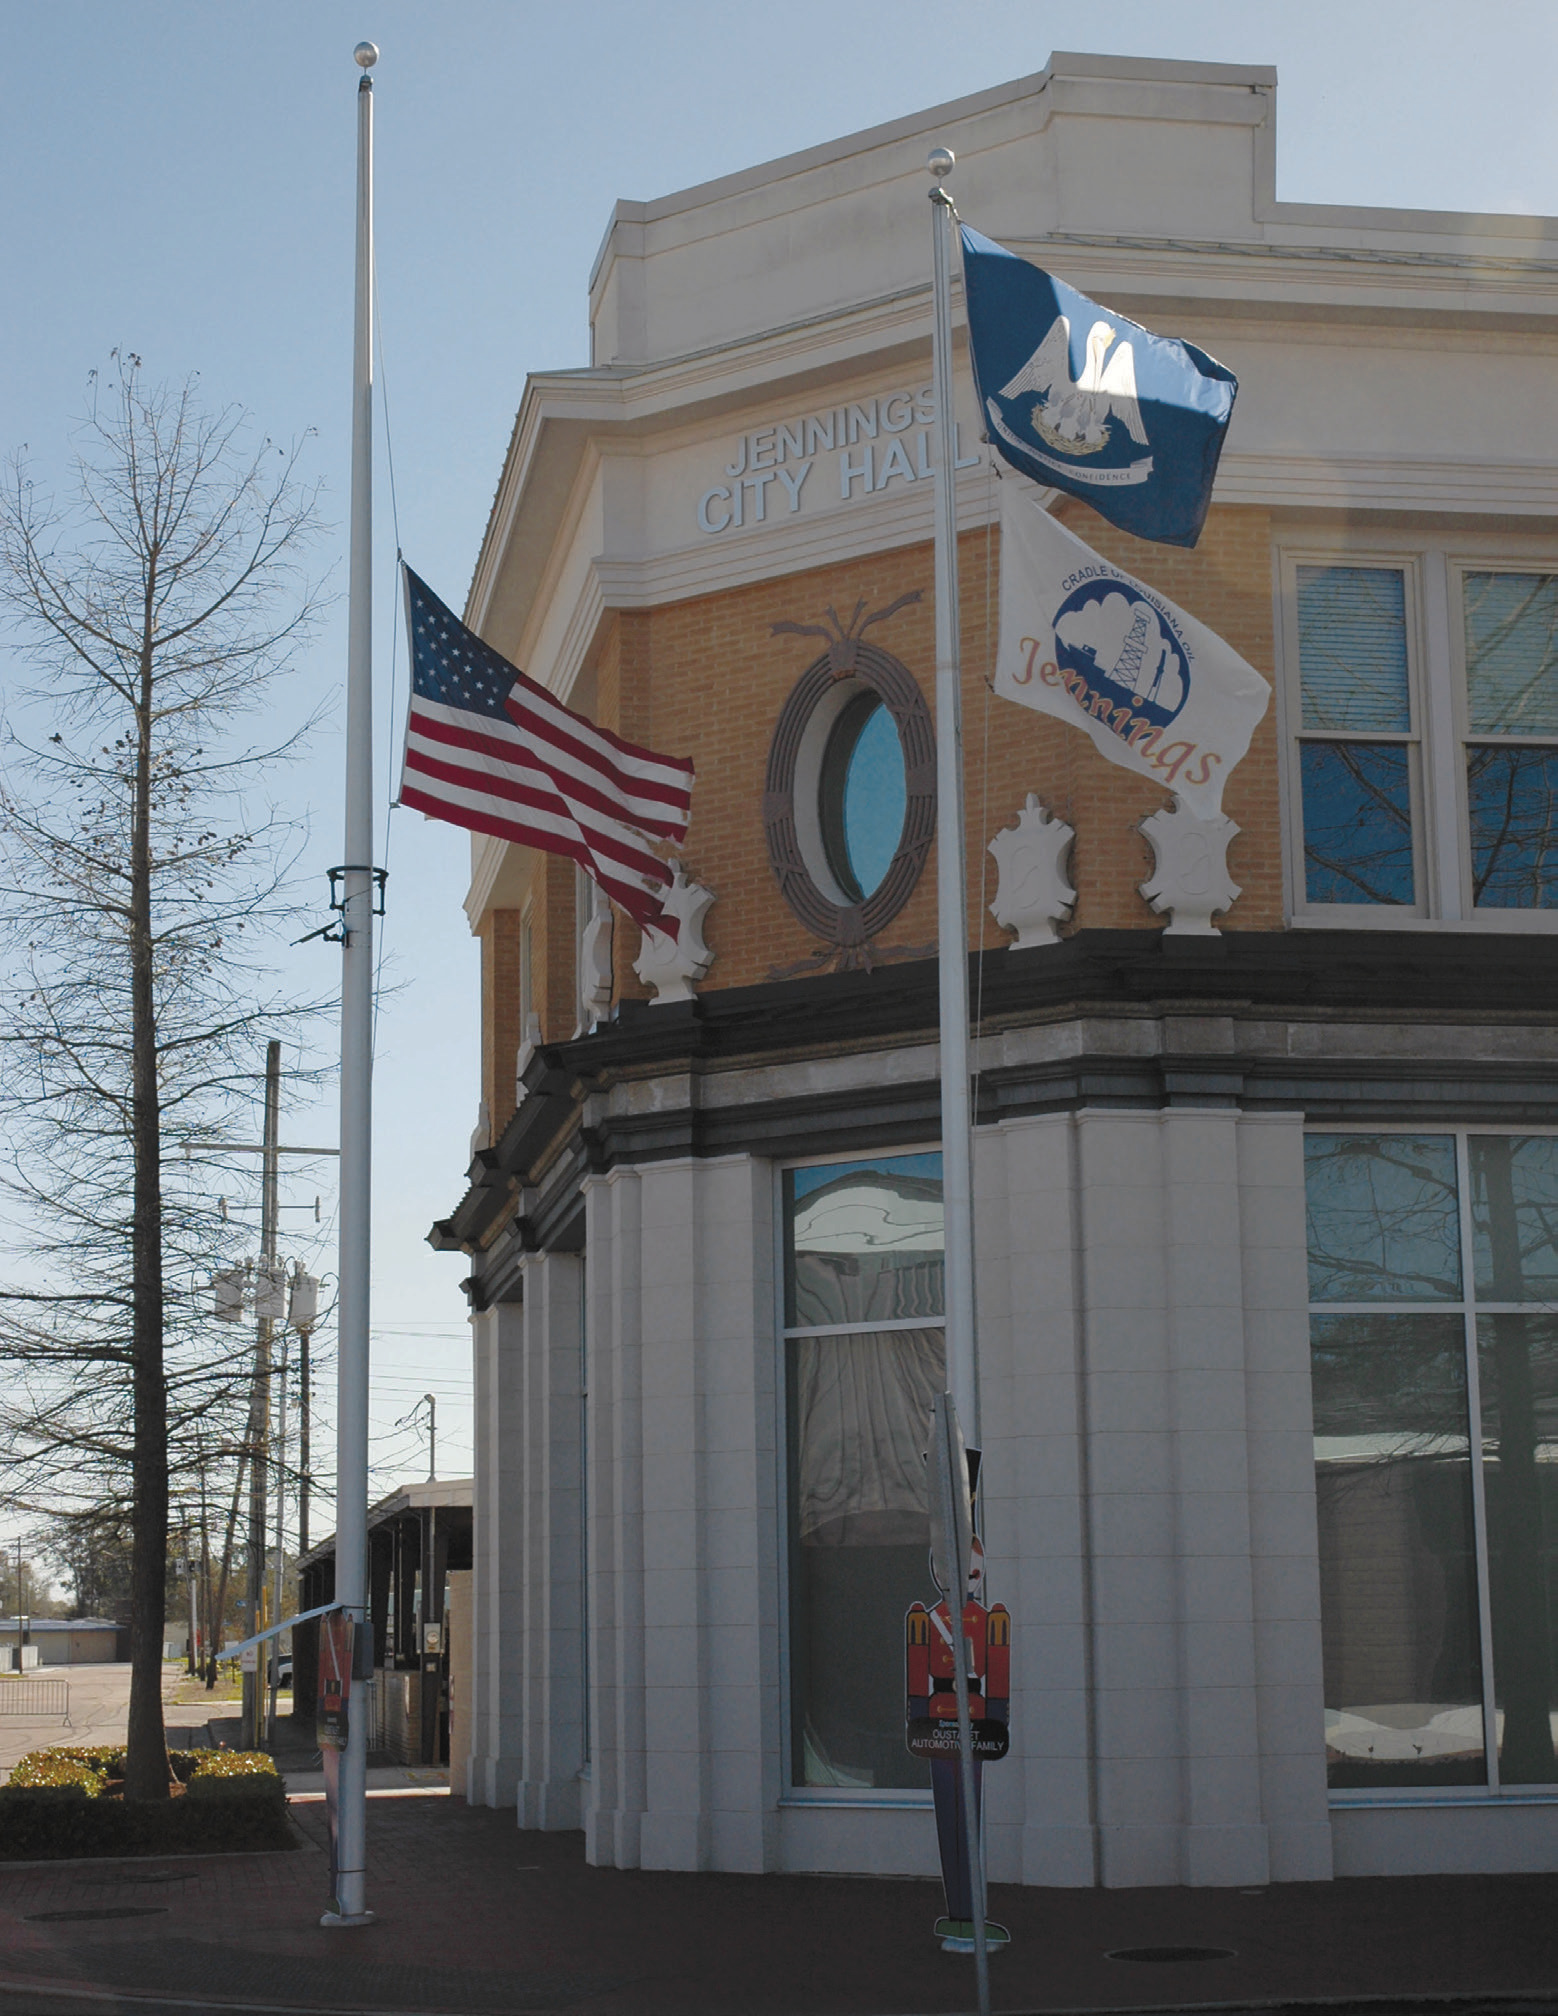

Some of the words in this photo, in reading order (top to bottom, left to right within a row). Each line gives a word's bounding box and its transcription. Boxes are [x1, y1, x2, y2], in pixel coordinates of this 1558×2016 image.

[726, 384, 937, 477] JENNINGS
[698, 462, 813, 534] CITY
[840, 423, 980, 500] HALL
[1061, 565, 1109, 592] CRADLE
[1129, 580, 1184, 639] LUISIANA
[1011, 636, 1222, 784] Jennings
[911, 1739, 961, 1750] AUTOMOTIV
[972, 1741, 1004, 1750] FAMILY
[933, 1729, 980, 1740] OUSTET
